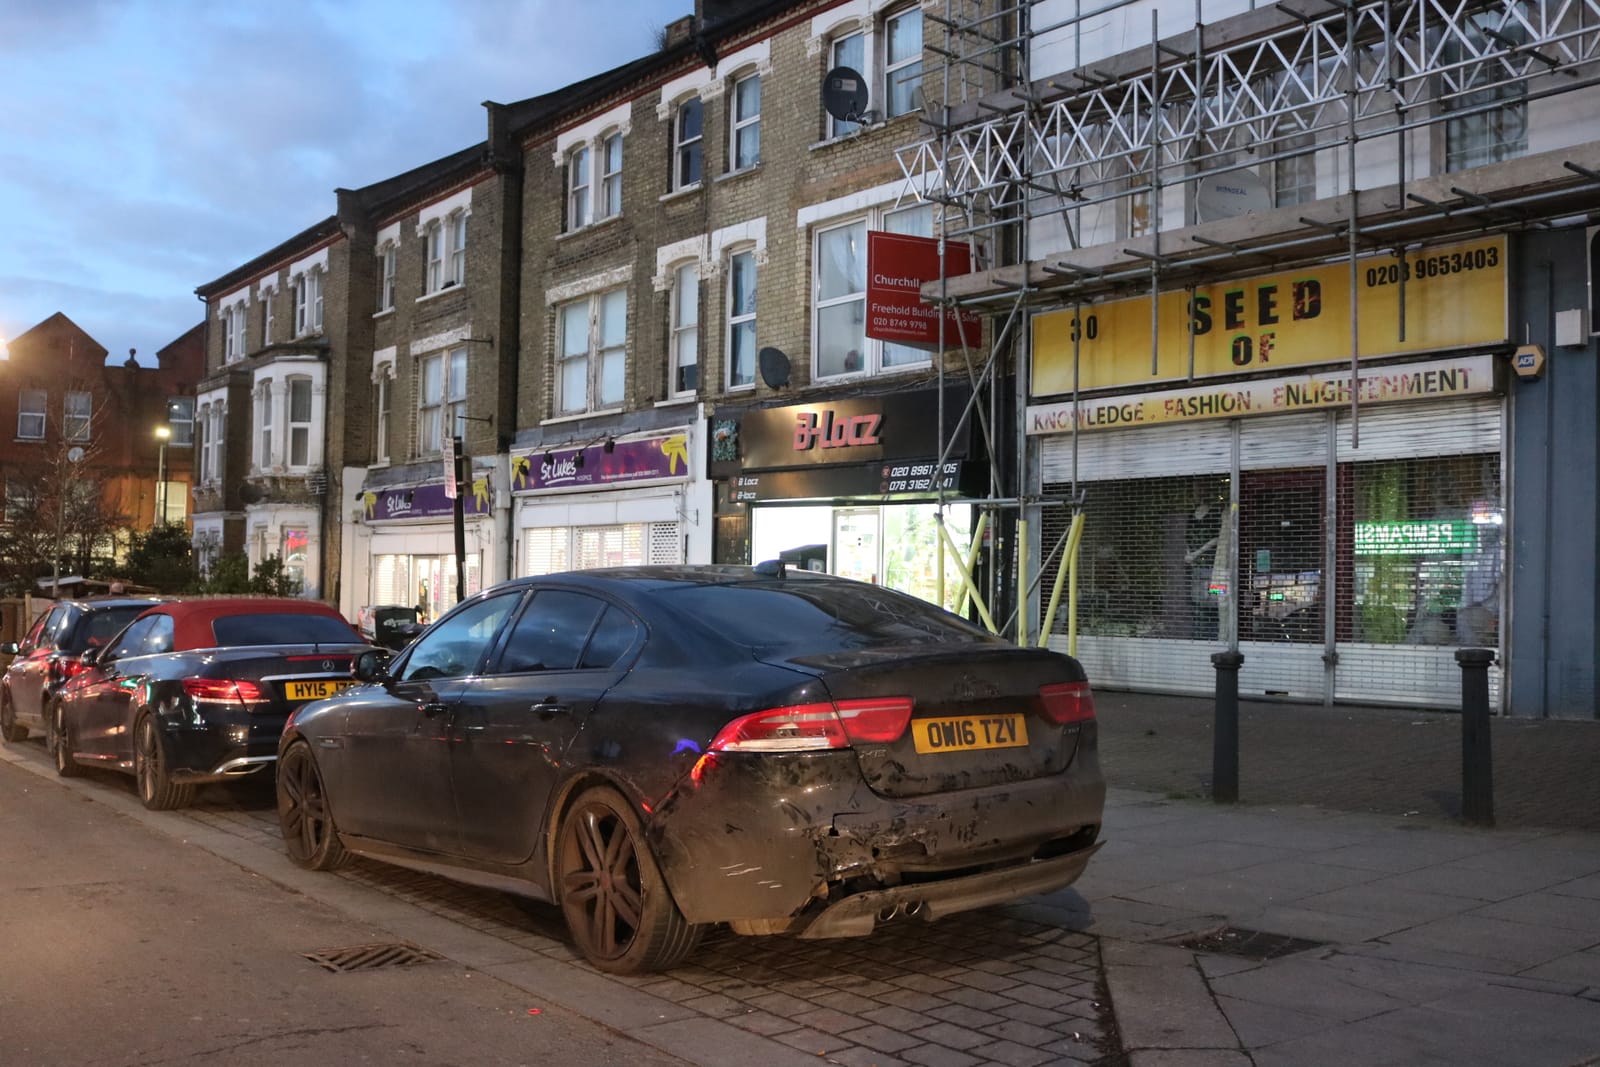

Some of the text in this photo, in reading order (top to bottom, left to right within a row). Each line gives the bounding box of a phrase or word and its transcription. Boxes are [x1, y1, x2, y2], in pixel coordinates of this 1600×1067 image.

[1416, 246, 1498, 279] 9653403
[874, 274, 920, 288] Churchill
[872, 303, 978, 323] Freehold Buildin Fo Sale
[1187, 277, 1322, 335] SEED
[873, 317, 888, 326] 020
[890, 319, 908, 327] 8749
[1070, 315, 1098, 342] 30
[1231, 332, 1276, 366] OF
[1519, 356, 1535, 366] ADT
[1034, 368, 1473, 431] KNOWLEDGE FASHION ENLIGHTENMENT
[540, 456, 577, 480] St Luke's
[891, 467, 909, 477] 020
[911, 465, 933, 476] 8961
[889, 481, 906, 491] 078
[908, 479, 929, 490] 3162
[294, 683, 327, 697] HY15
[927, 718, 1016, 748] OW16 TZV
